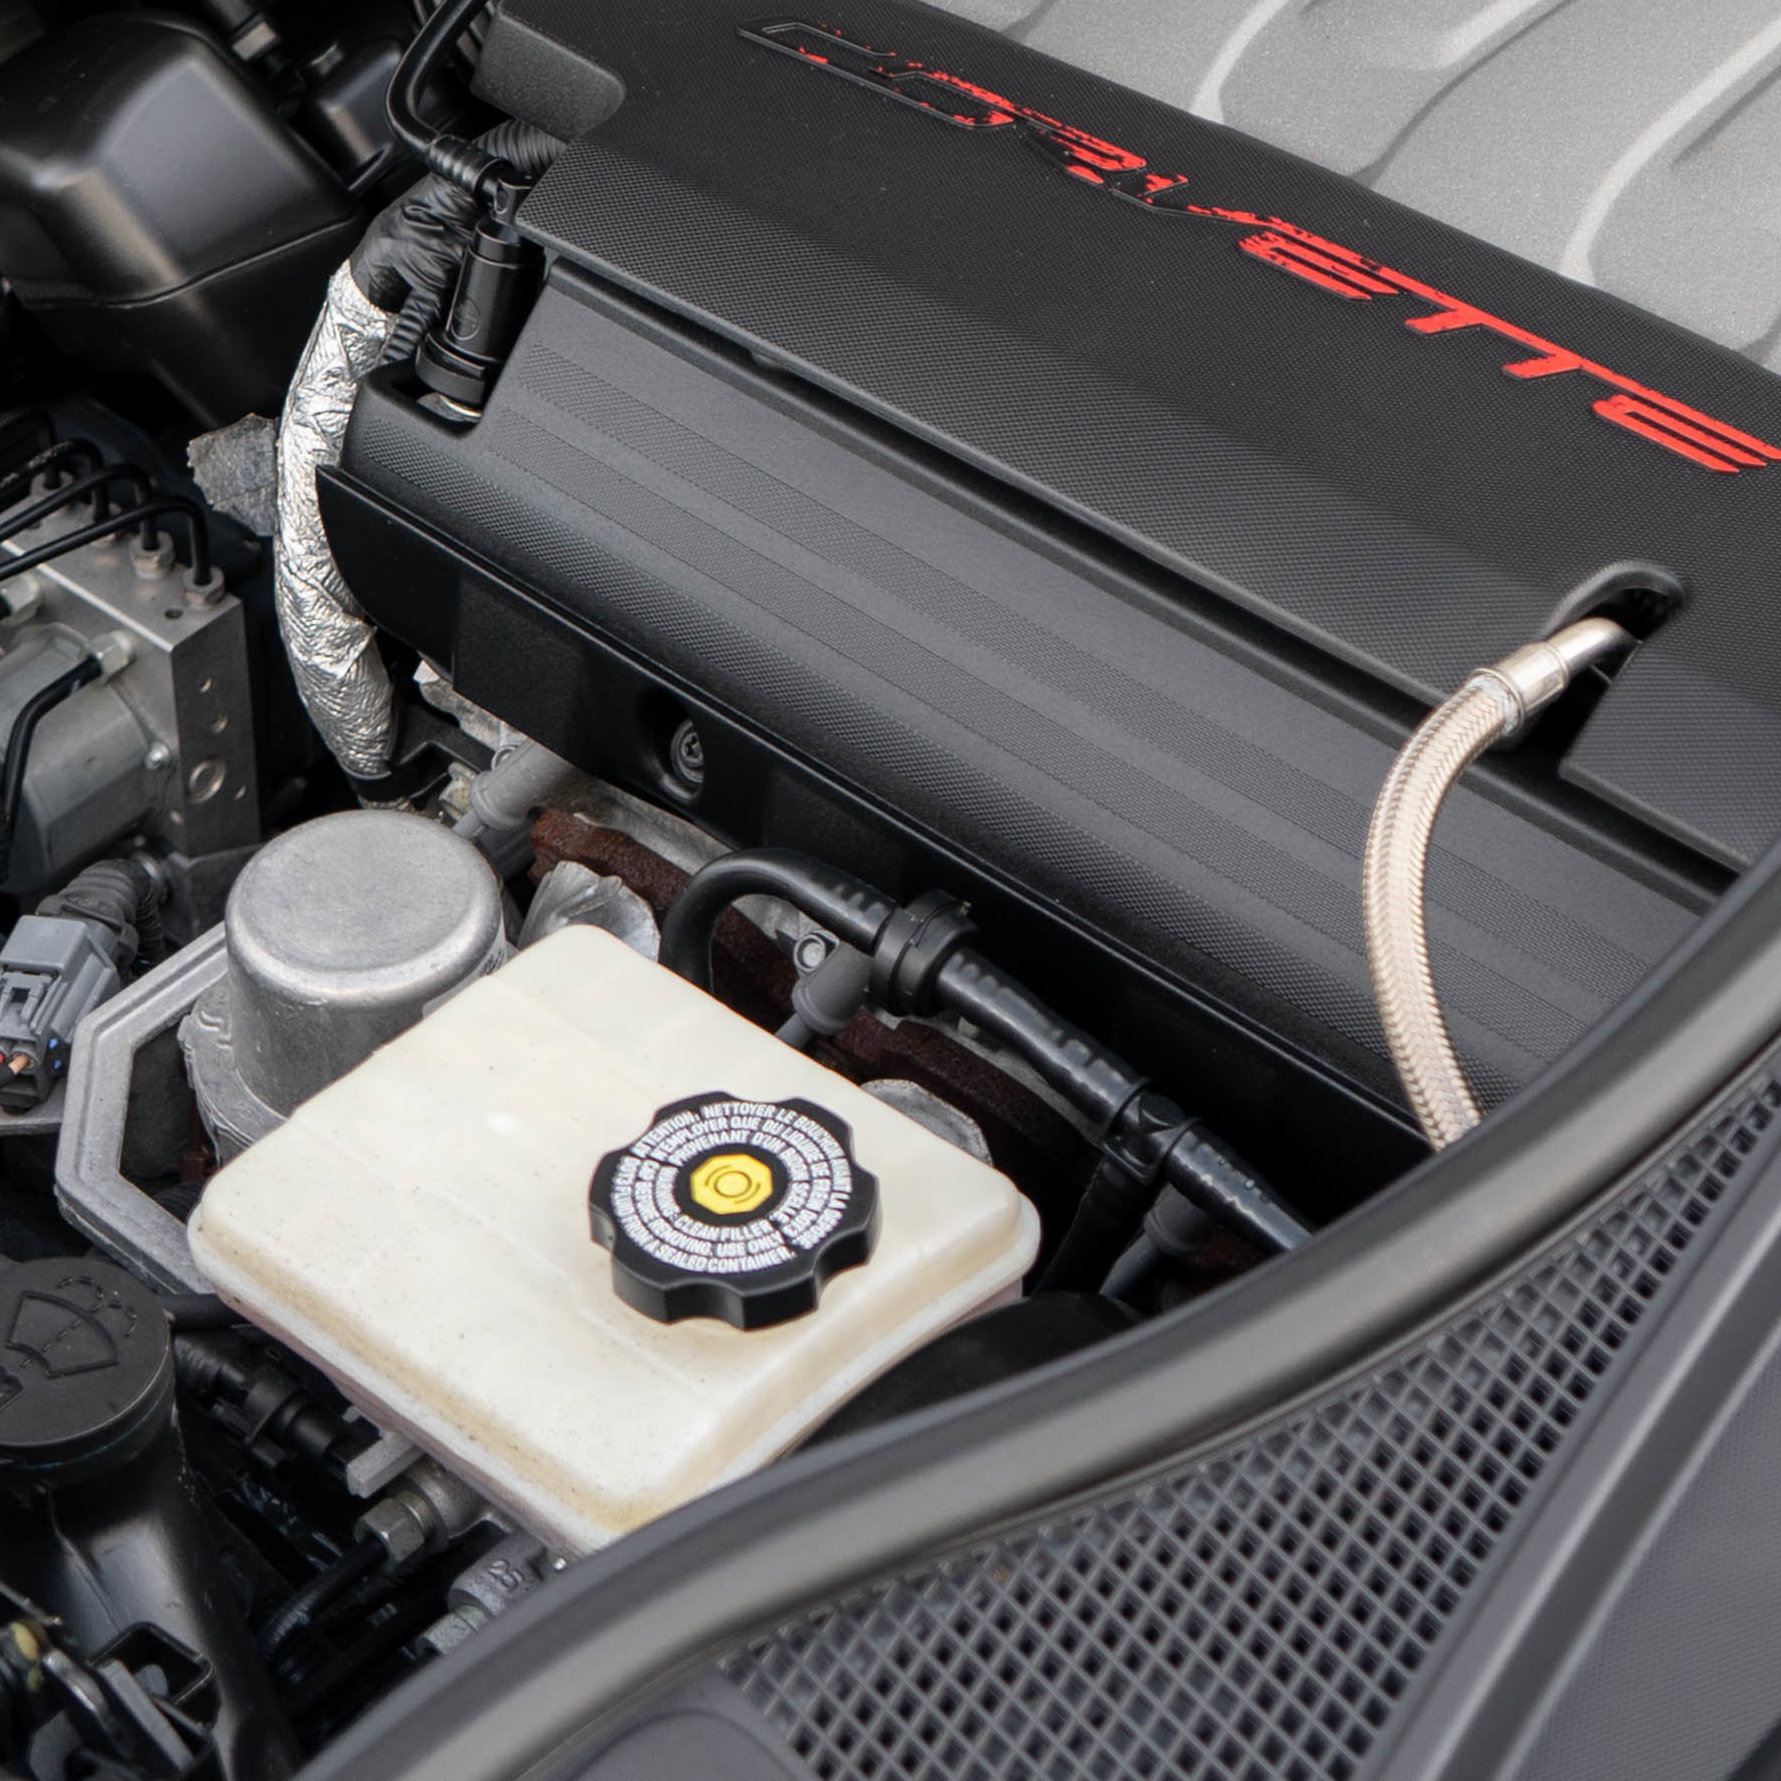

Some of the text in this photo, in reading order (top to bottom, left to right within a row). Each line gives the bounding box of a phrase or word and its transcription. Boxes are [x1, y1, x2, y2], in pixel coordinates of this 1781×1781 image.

[629, 1109, 700, 1158] ATTENTION:
[700, 1100, 777, 1120] NETTOYER
[775, 1106, 797, 1124] LE
[793, 1113, 846, 1160] BOUCHON
[648, 1117, 728, 1161] N'EMPLOYER
[730, 1115, 761, 1131] QUE
[762, 1118, 785, 1135] DU
[780, 1126, 826, 1164] LIQUIDE
[810, 1160, 830, 1178] DE
[667, 1129, 751, 1167] PROVENANT
[750, 1131, 786, 1154] D'UN
[778, 1146, 809, 1182] BIDON
[610, 1185, 636, 1218] FLUID
[618, 1214, 655, 1246] FROM
[634, 1181, 660, 1223] BEFORE
[647, 1217, 714, 1257] REMOVING.
[716, 1241, 747, 1257] USE
[747, 1230, 785, 1254] ONLY
[673, 1214, 720, 1241] CLEAN
[720, 1217, 775, 1243] FILLER
[643, 1239, 660, 1254] A
[654, 1244, 708, 1273] SEALED
[708, 1245, 798, 1274] CONTAINER.
